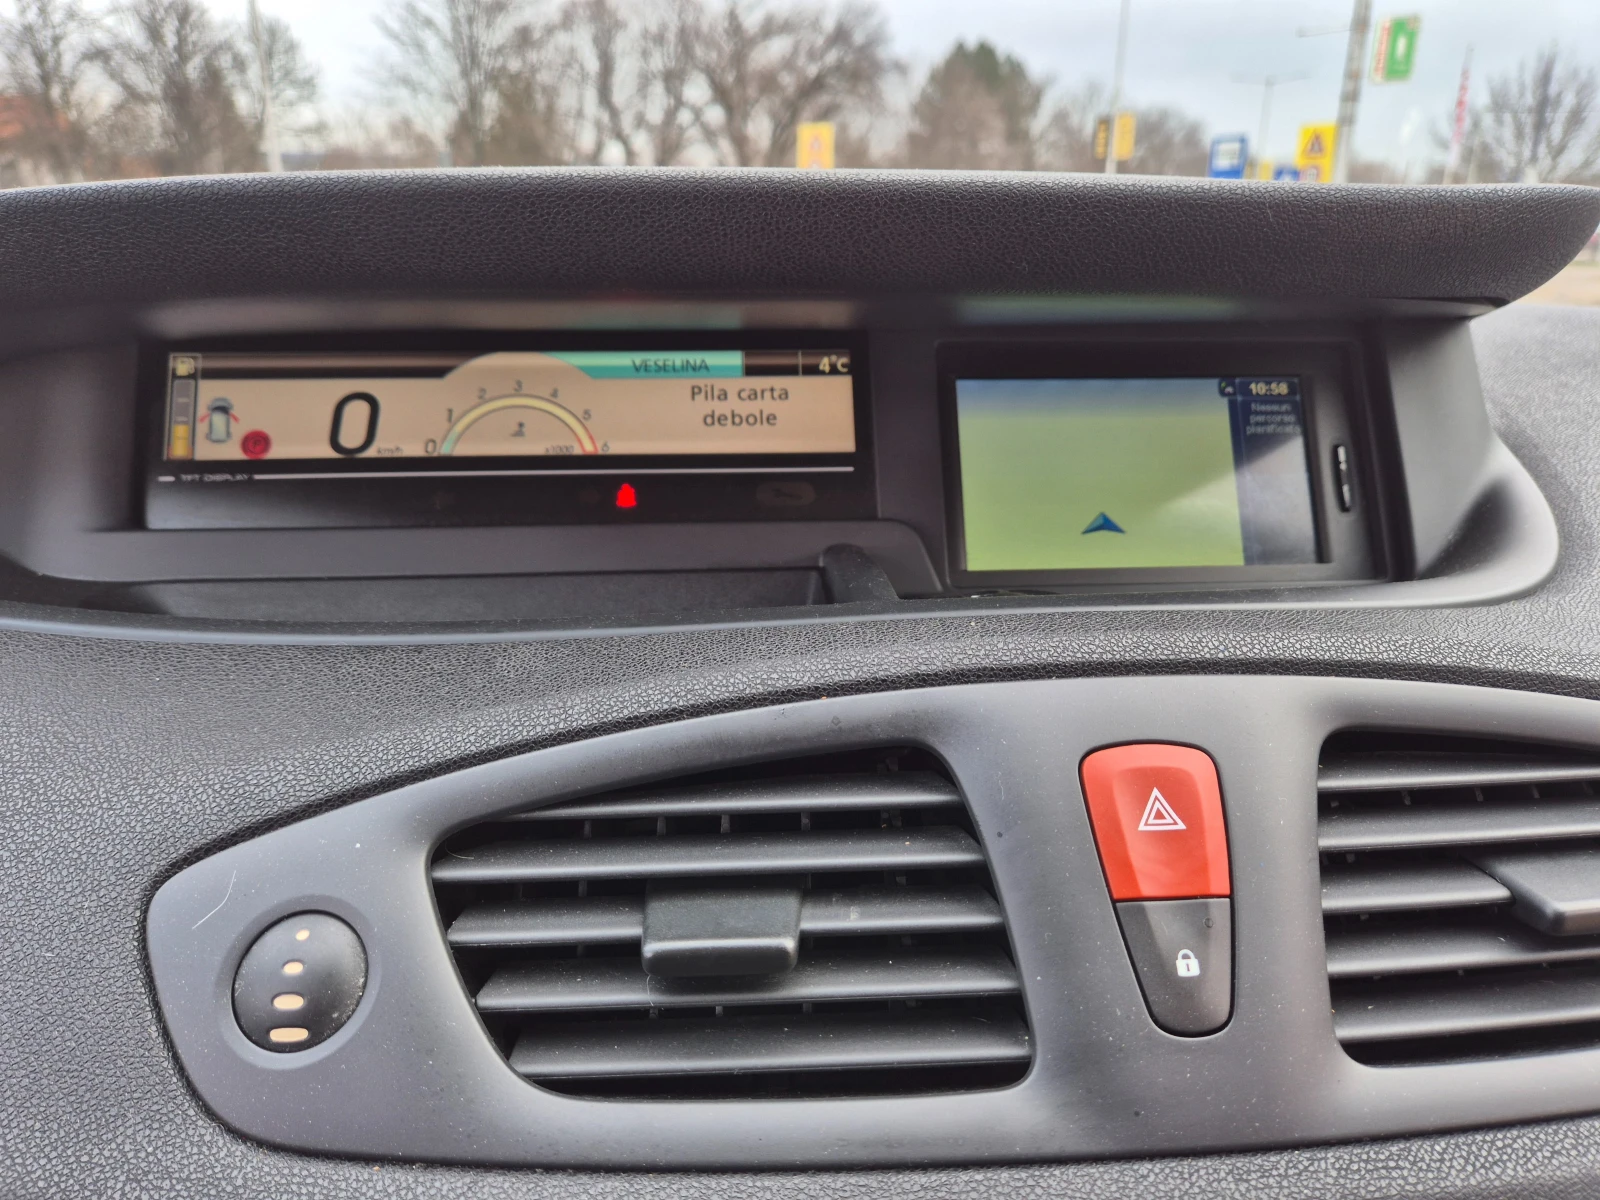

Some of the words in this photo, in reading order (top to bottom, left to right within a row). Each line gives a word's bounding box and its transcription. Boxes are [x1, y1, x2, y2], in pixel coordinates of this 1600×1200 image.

[631, 357, 711, 374] VESELINA
[818, 354, 849, 374] 4°C
[477, 387, 487, 400] 2
[513, 379, 523, 394] 3
[550, 387, 560, 400] 4
[690, 383, 729, 402] Pila
[737, 386, 790, 402] carta
[1249, 381, 1288, 395] 10:58
[446, 407, 454, 423] 1
[581, 408, 592, 422] 5
[702, 408, 778, 427] debole
[329, 391, 381, 457] 0
[424, 438, 438, 456] 0
[601, 440, 611, 456] 6
